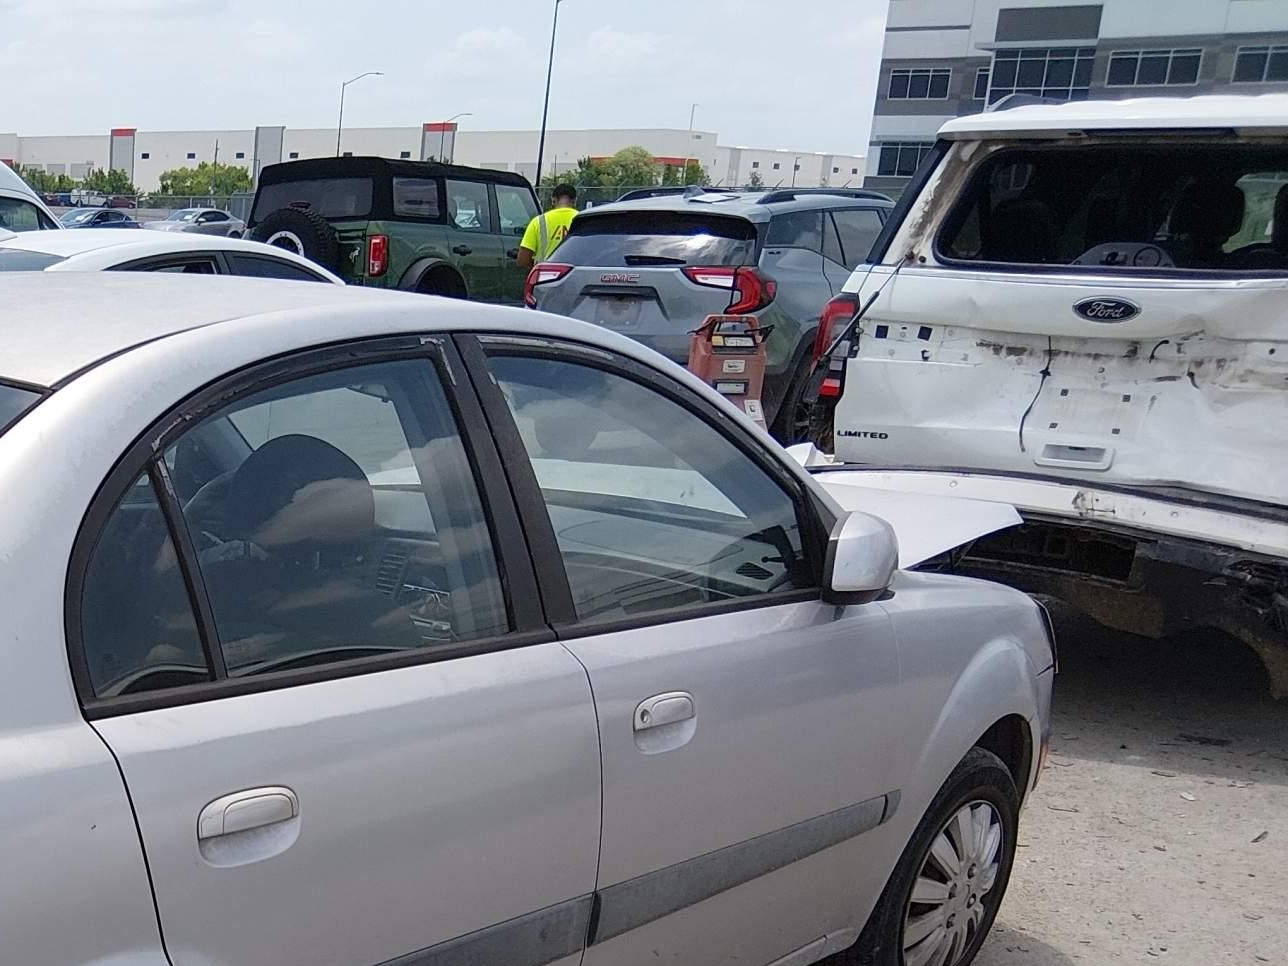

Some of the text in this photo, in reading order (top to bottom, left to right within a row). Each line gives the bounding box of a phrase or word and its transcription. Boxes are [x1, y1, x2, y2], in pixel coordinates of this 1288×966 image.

[600, 273, 640, 283] GMC
[1086, 301, 1125, 318] Ford
[836, 430, 889, 440] LIMITED
